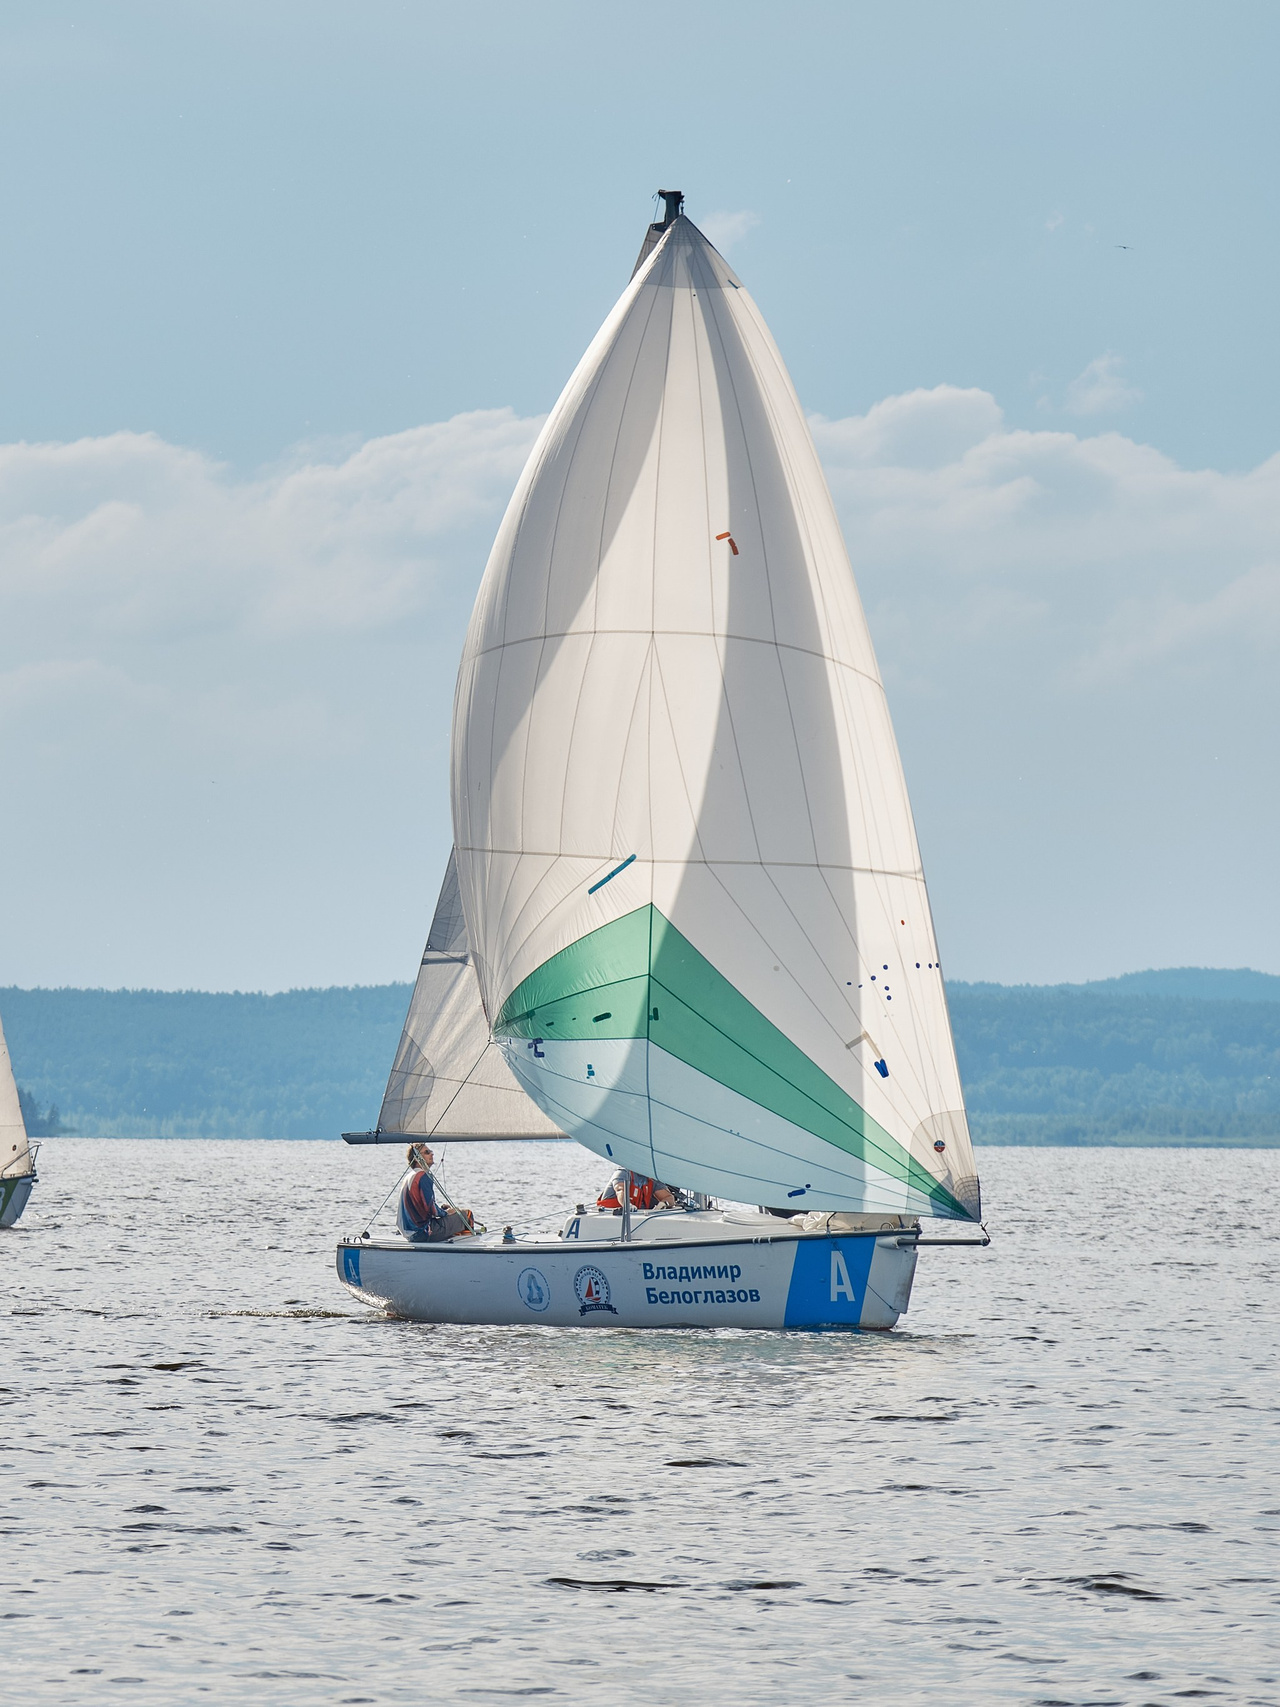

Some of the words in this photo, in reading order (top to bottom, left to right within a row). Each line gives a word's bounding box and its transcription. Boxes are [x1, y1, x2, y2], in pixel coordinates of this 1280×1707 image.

[565, 1217, 581, 1239] A
[348, 1258, 358, 1280] A
[642, 1262, 741, 1282] Владимир
[830, 1250, 856, 1302] A
[645, 1287, 761, 1304] Белоглазов
